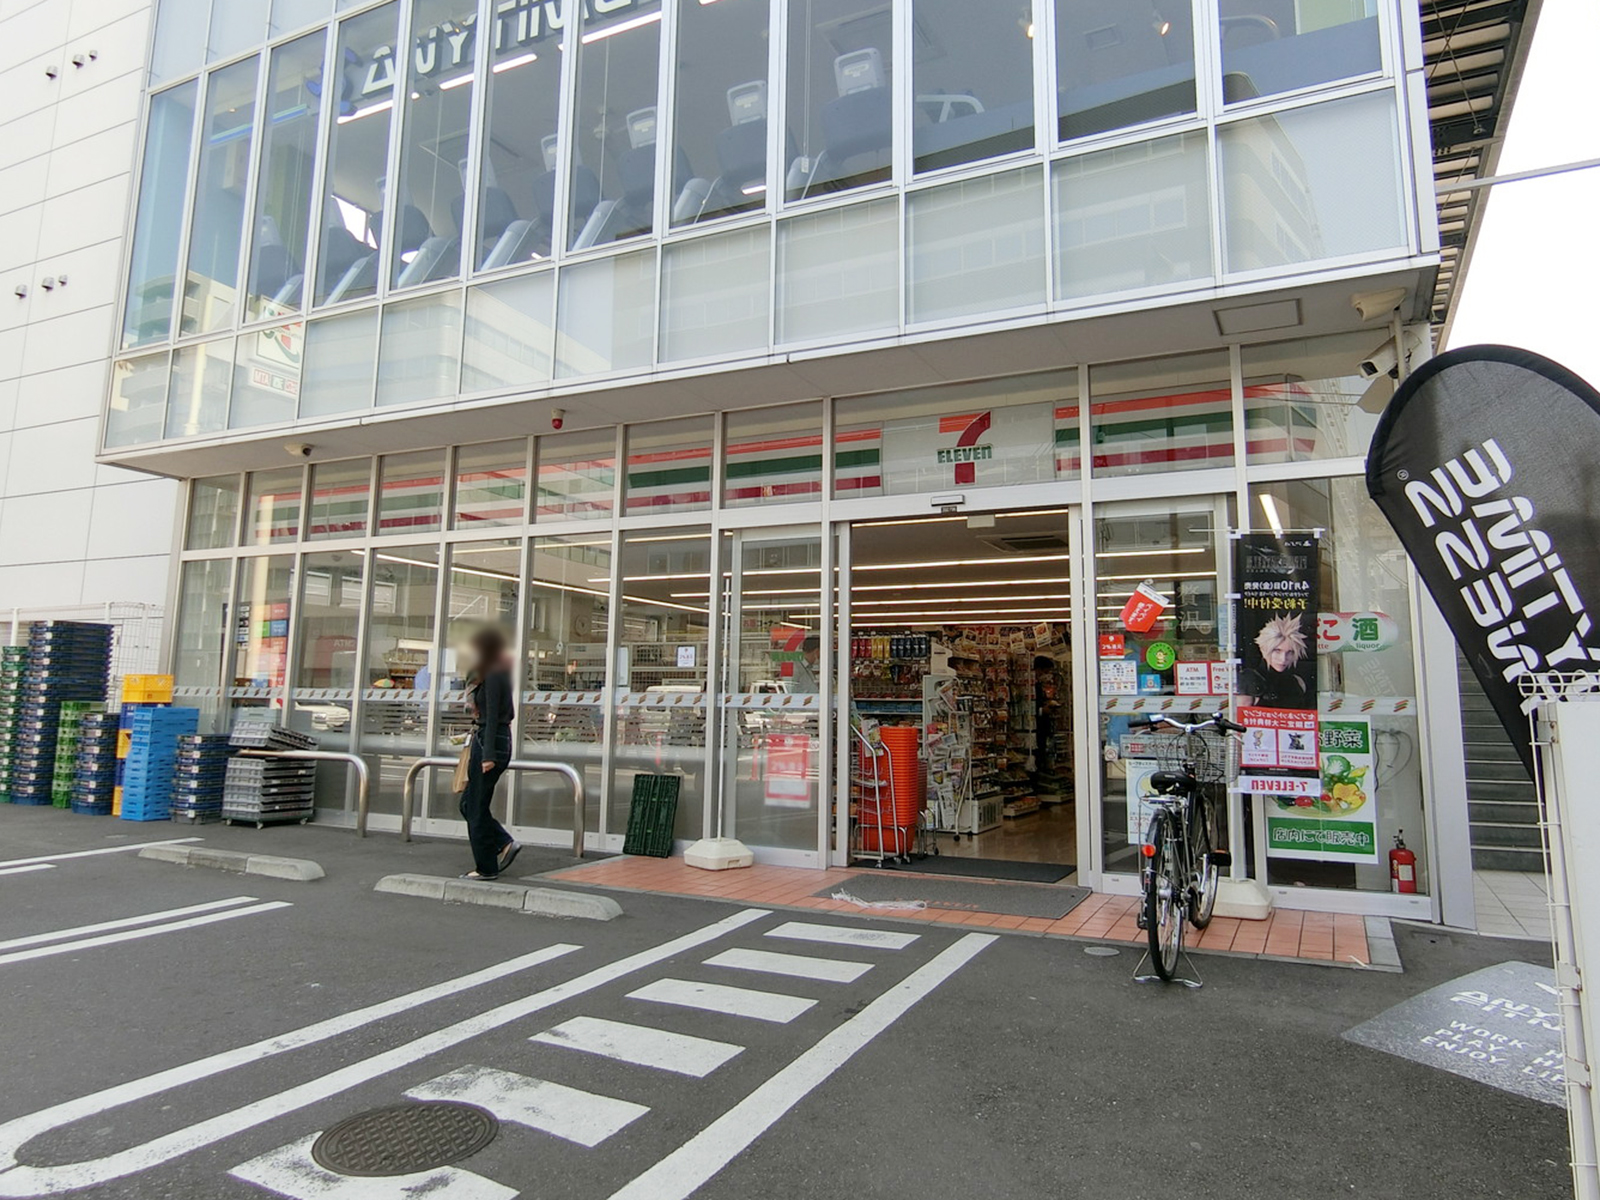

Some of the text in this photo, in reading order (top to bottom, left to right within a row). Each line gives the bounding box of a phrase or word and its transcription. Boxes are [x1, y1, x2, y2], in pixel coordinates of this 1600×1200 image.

[1352, 617, 1379, 641] 酒
[1356, 643, 1380, 652] liquor
[1318, 729, 1363, 749] 野菜
[1272, 827, 1370, 847] 店内にて販売中
[1434, 1028, 1505, 1052] PLAY
[1450, 1020, 1531, 1049] WORK
[1420, 1036, 1566, 1081] ENJOY LIF
